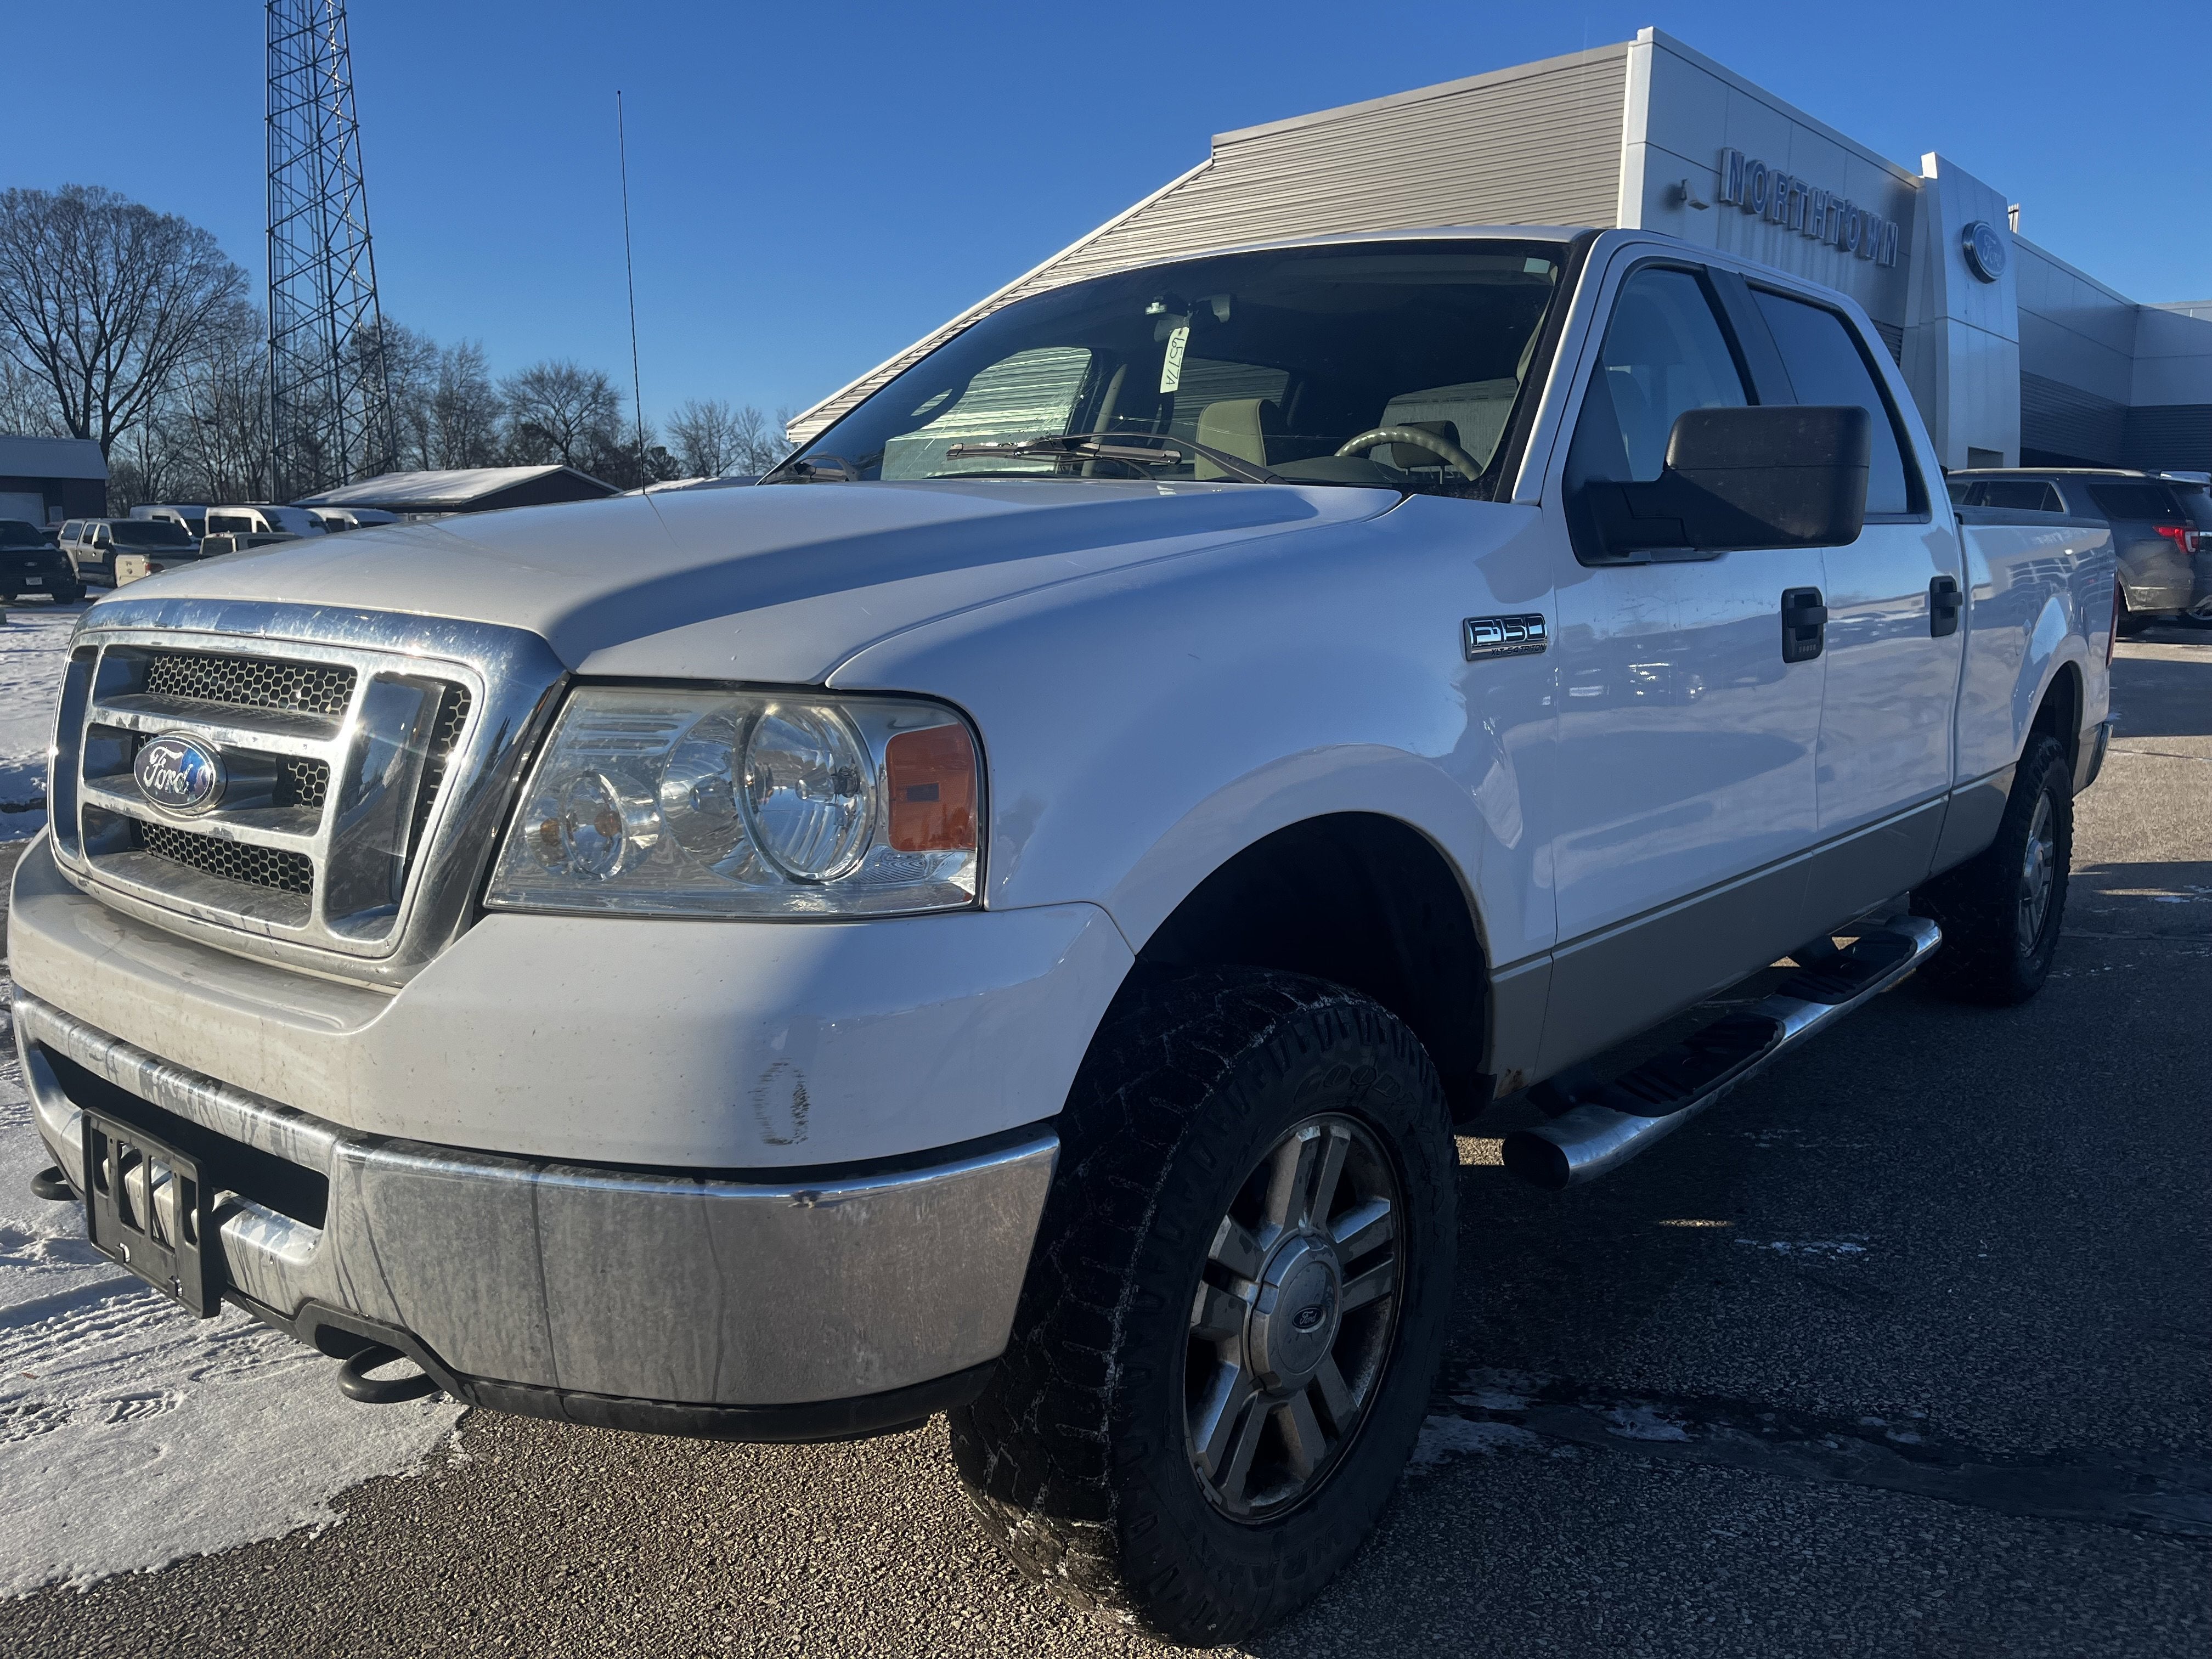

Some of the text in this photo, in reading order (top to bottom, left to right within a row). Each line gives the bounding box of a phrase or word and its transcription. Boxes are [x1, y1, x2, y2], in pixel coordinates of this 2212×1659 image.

[1720, 147, 1899, 267] NORTHTOWN
[1166, 337, 1185, 385] 6577A
[1520, 644, 1545, 653] TRITON
[143, 746, 194, 794] Ford
[1299, 1311, 1317, 1325] Ford
